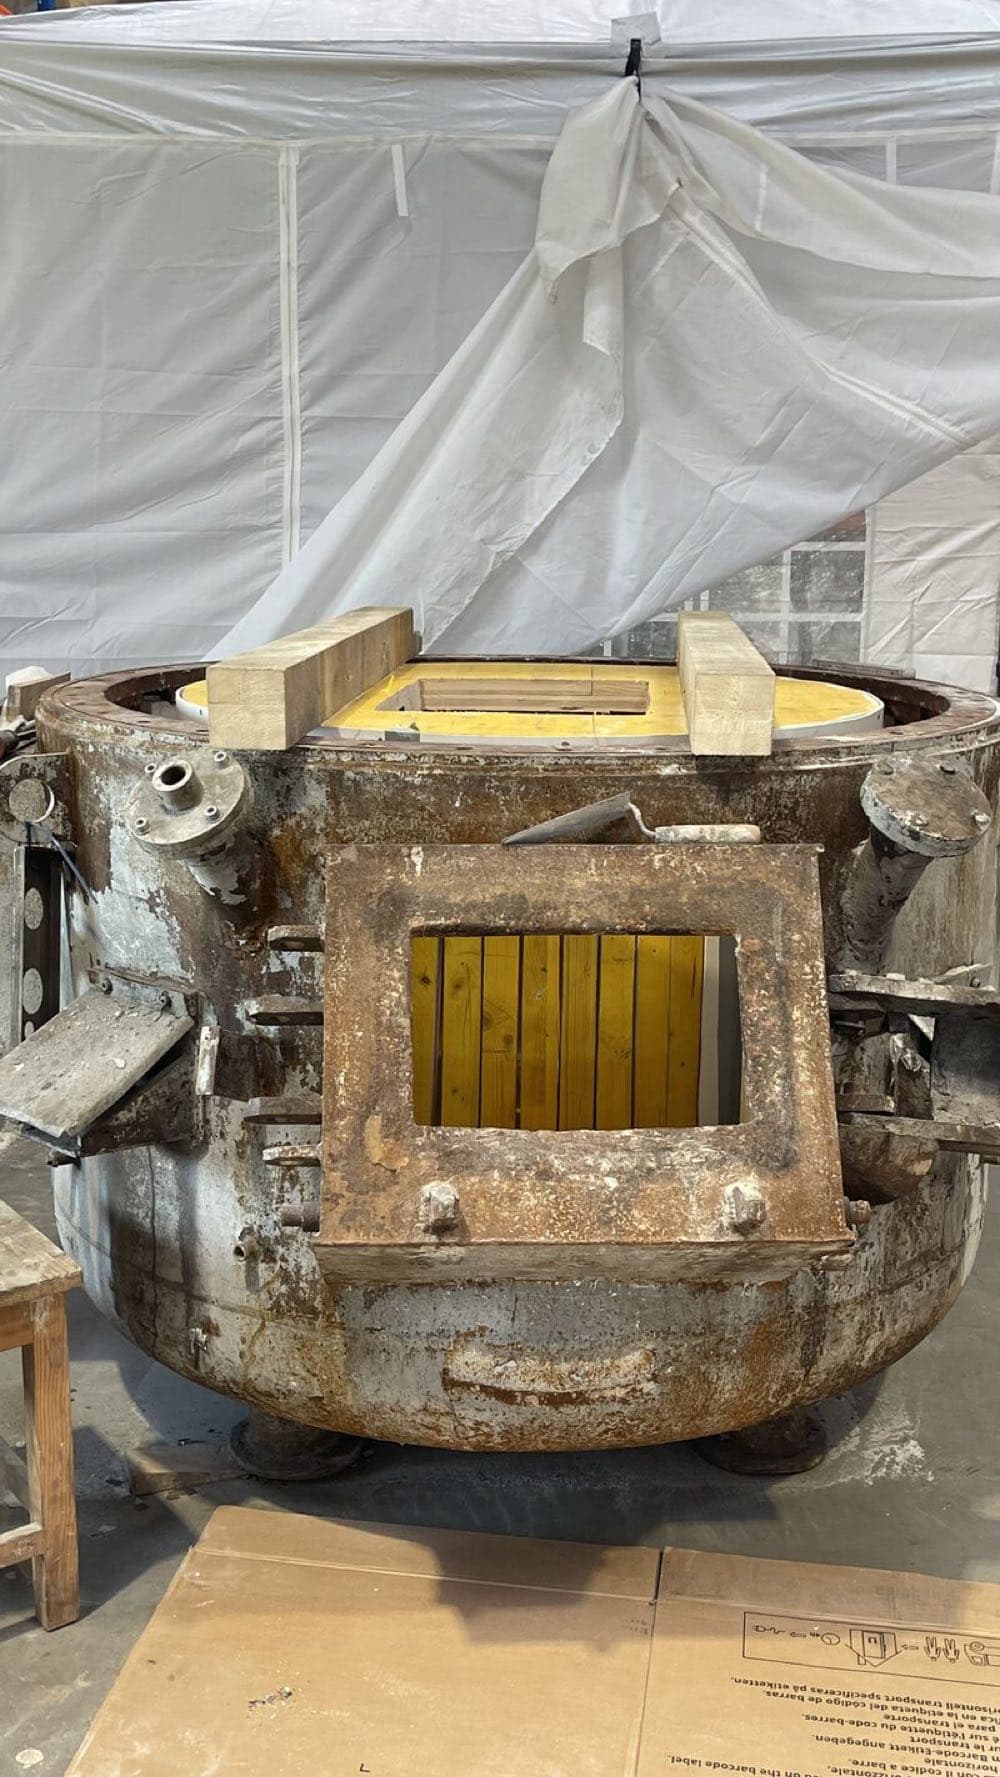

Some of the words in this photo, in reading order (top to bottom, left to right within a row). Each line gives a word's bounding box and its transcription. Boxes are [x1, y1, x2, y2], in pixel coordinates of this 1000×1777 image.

[731, 1677, 789, 1689] etiketten.
[763, 1690, 805, 1702] barras.
[810, 1686, 881, 1700] specificeras
[808, 1696, 822, 1704] de
[826, 1697, 866, 1708] código
[885, 1695, 943, 1708] transport
[869, 1703, 888, 1711] del
[891, 1705, 944, 1717] etiqueta
[802, 1714, 877, 1728] code-barres.
[883, 1714, 950, 1727] transporte
[947, 1712, 958, 1720] la
[881, 1723, 897, 1731] du
[953, 1721, 964, 1729] el
[968, 1724, 996, 1732] para
[900, 1725, 965, 1740] l'étiquette
[969, 1733, 989, 1741] sur
[812, 1734, 885, 1748] angegeben.
[910, 1736, 970, 1749] transport
[889, 1743, 988, 1762] Barcode-Etikett
[973, 1744, 985, 1752] le
[668, 1755, 702, 1767] label.
[705, 1760, 756, 1774] barcode
[848, 1759, 886, 1770] barre.
[924, 1758, 998, 1773] horizontale
[760, 1767, 781, 1777] the
[901, 1765, 942, 1776] codice
